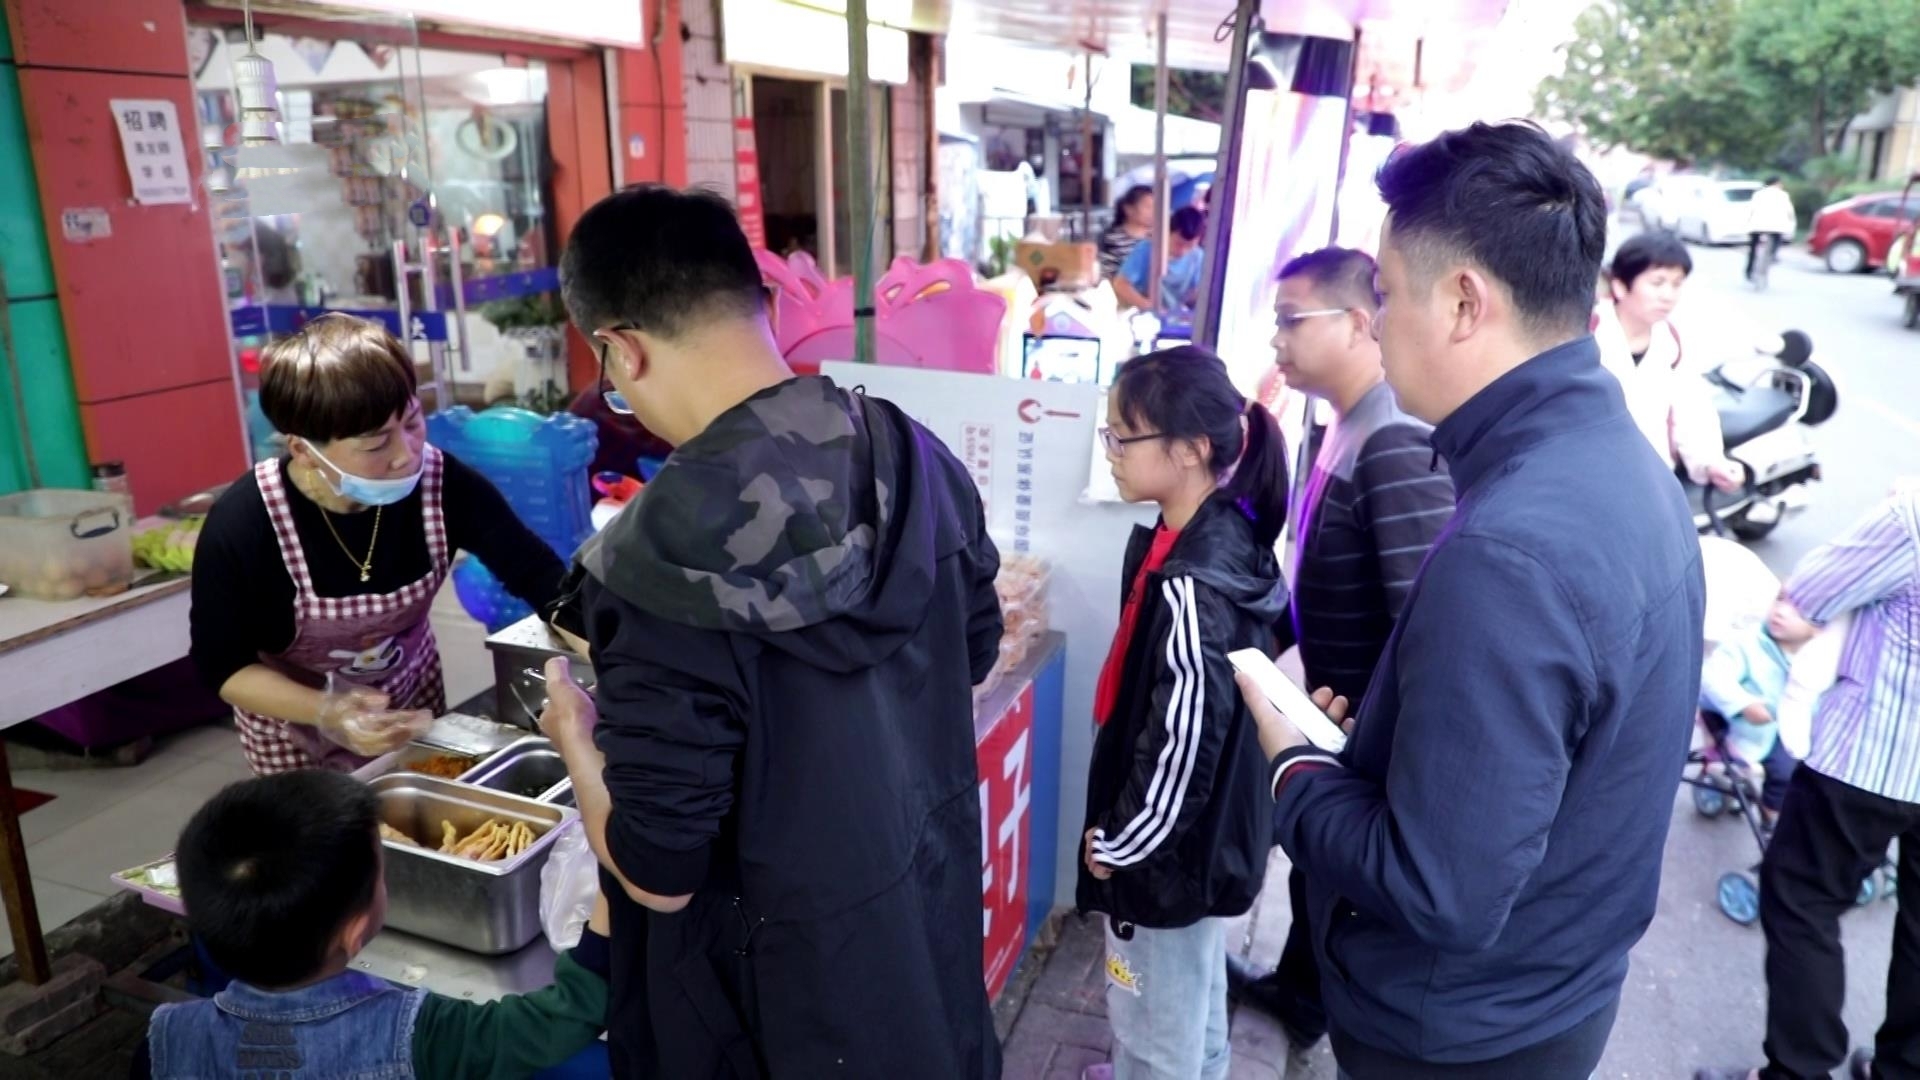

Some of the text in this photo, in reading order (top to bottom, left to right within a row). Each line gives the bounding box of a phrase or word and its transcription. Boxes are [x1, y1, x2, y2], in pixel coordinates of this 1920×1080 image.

[123, 109, 168, 132] 招聘
[1014, 431, 1034, 552] 国际质量体系认证
